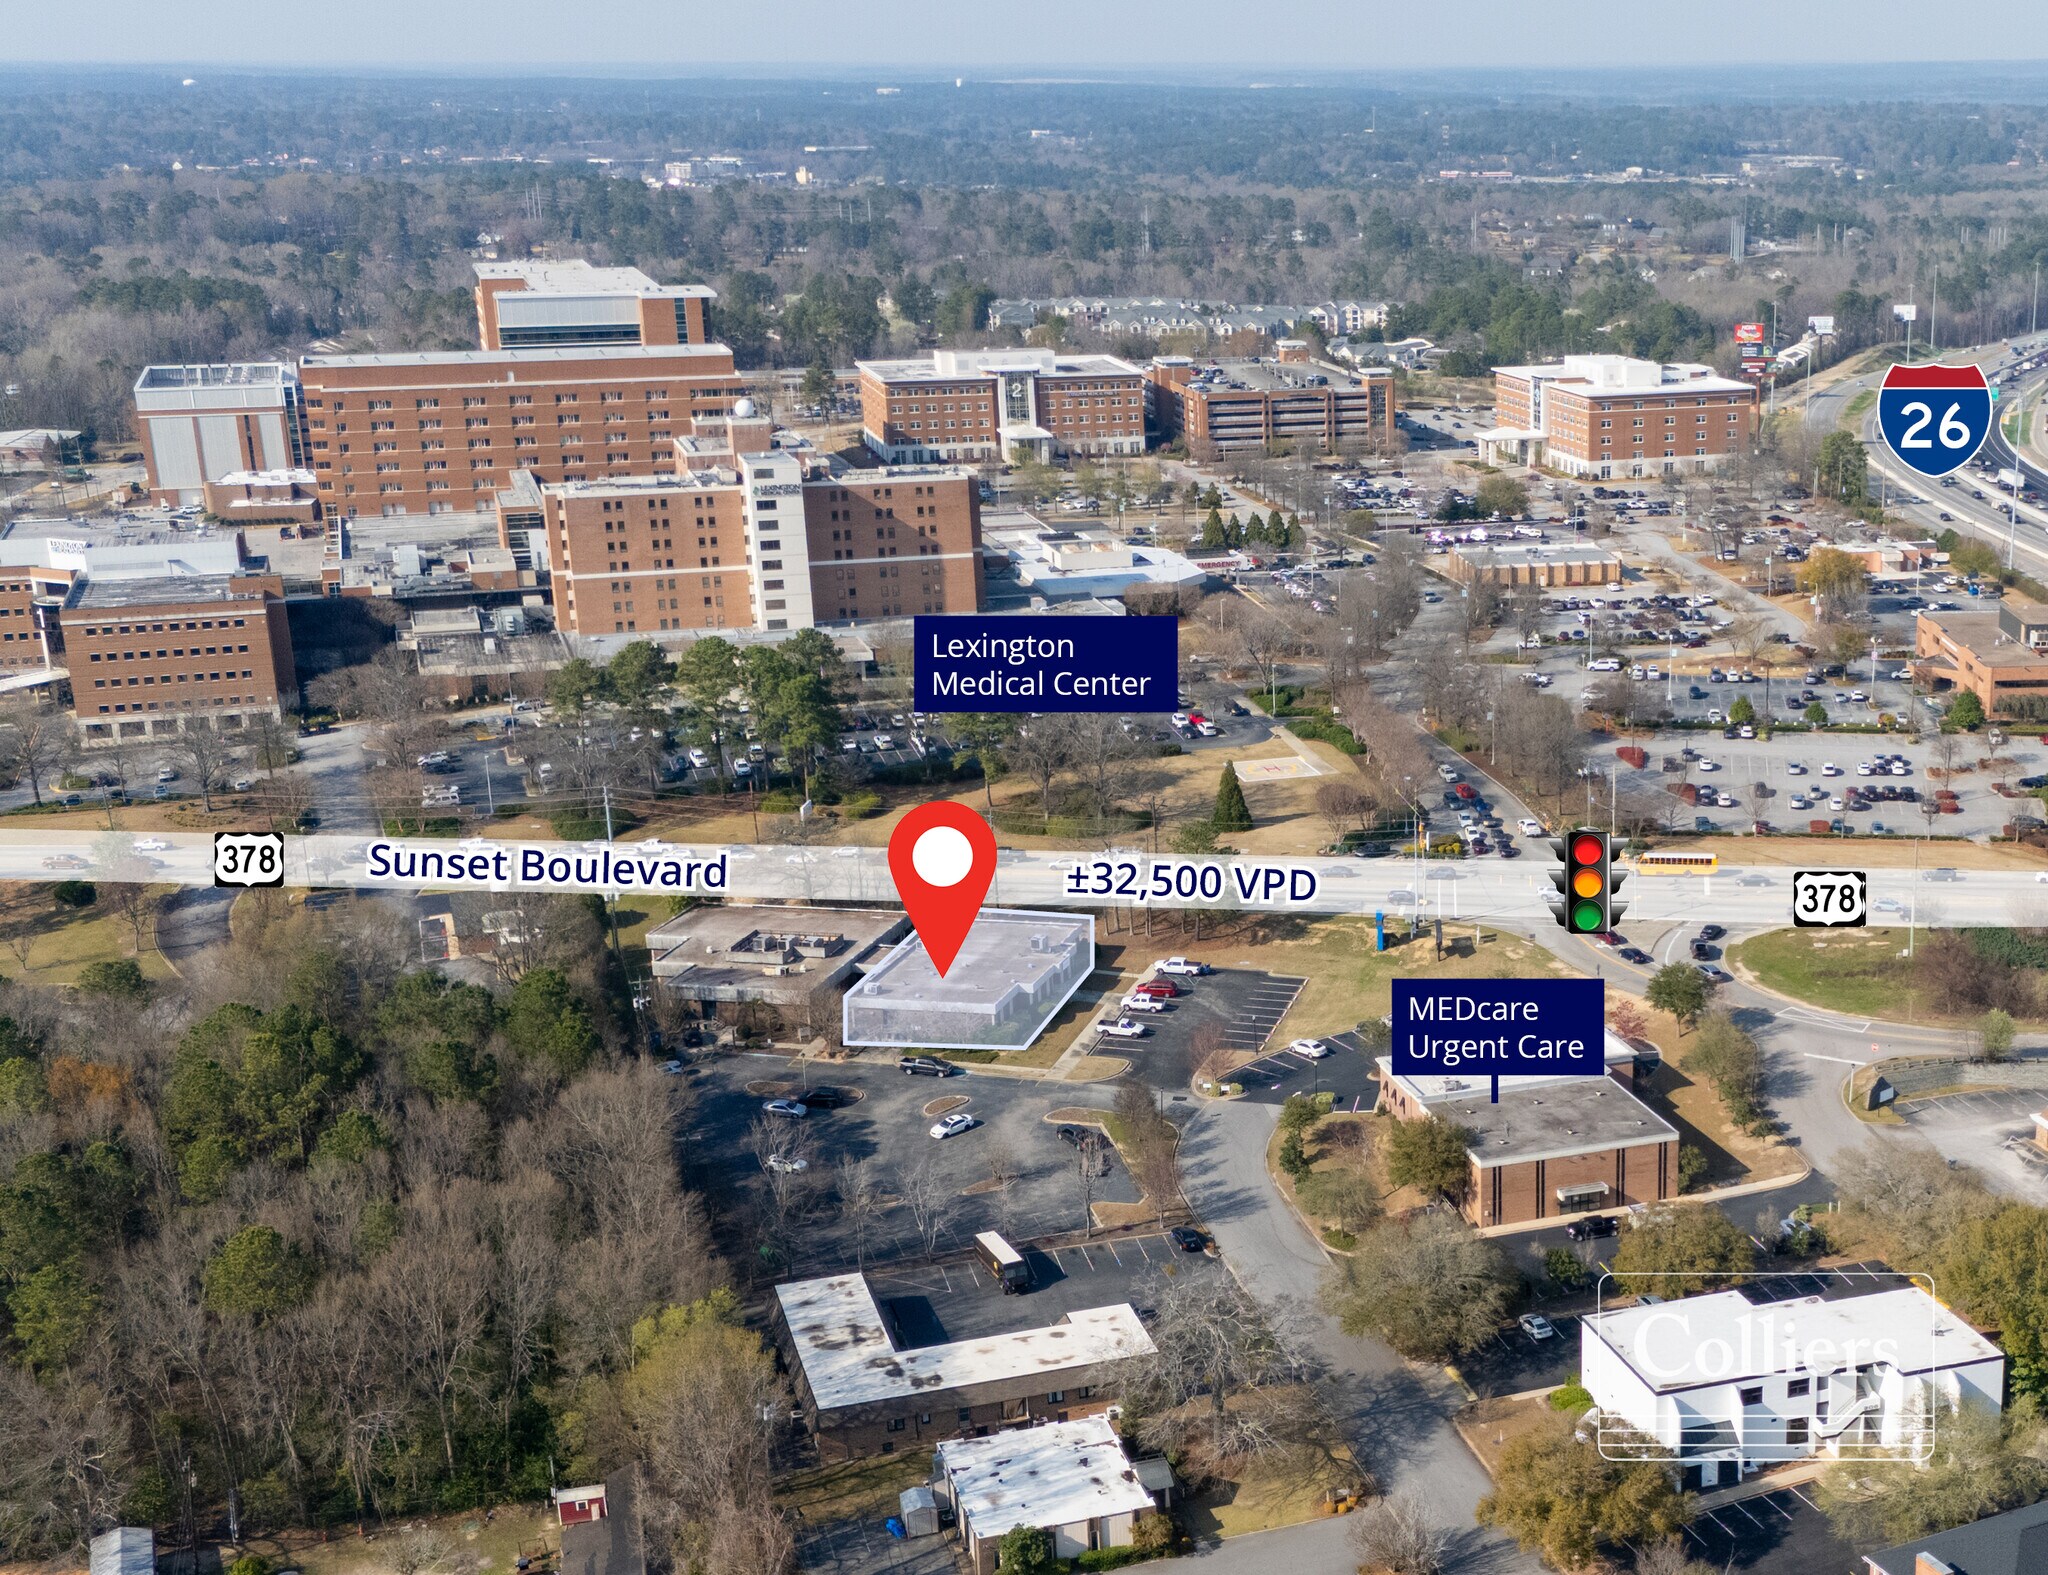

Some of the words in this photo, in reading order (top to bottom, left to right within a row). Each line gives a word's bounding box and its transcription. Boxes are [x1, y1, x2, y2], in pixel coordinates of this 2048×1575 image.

[1012, 383, 1022, 398] 2
[1197, 561, 1240, 569] EMERGENCY
[36, 608, 45, 628] 1
